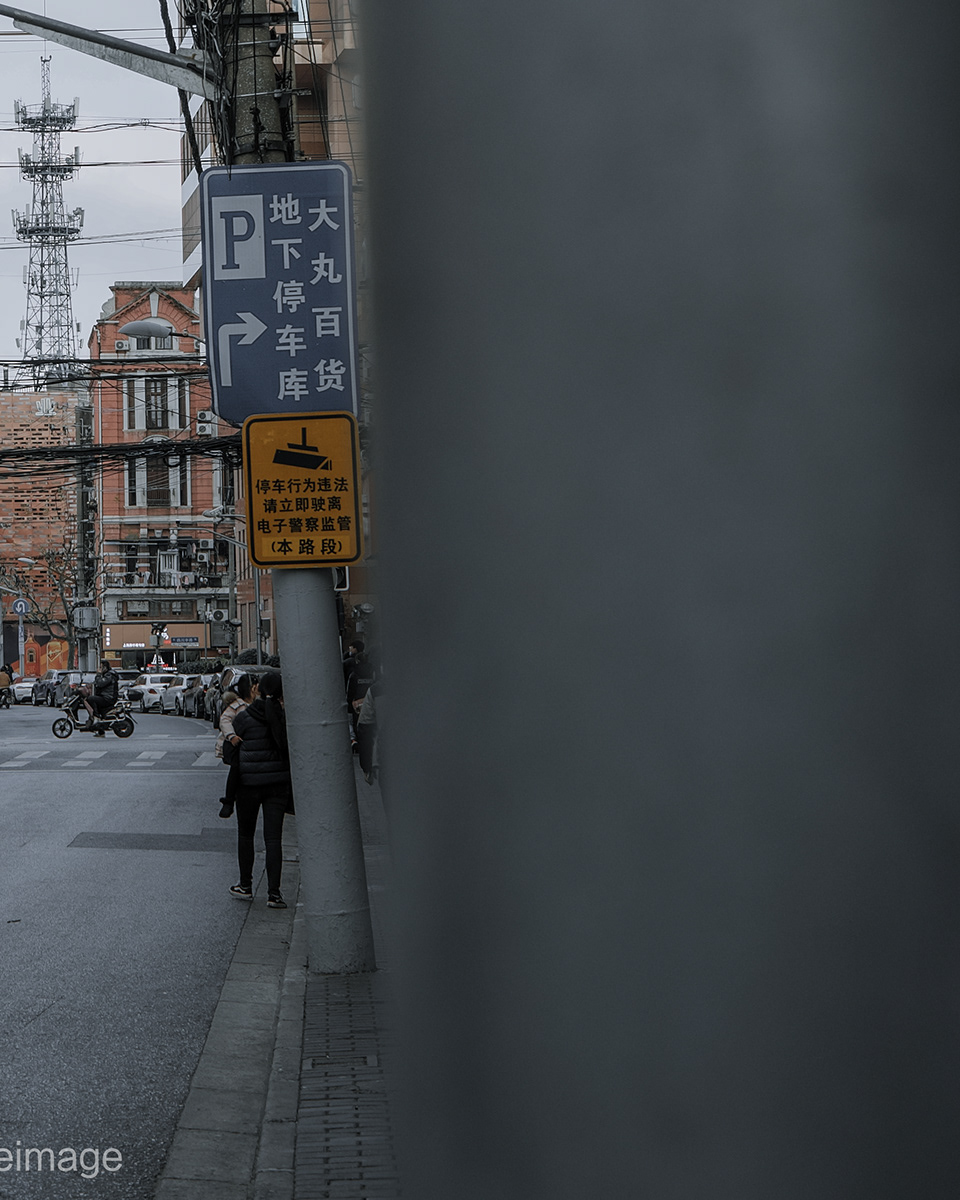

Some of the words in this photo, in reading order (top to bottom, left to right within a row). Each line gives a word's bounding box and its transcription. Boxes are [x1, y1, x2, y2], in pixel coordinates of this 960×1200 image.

[269, 193, 309, 401] 地下停车库
[308, 199, 346, 392] 大丸百货
[255, 477, 349, 495] 停车行为违法
[263, 496, 342, 513] 请立即驶离
[257, 516, 352, 534] 电子警察监管
[271, 538, 342, 555] (本路段)
